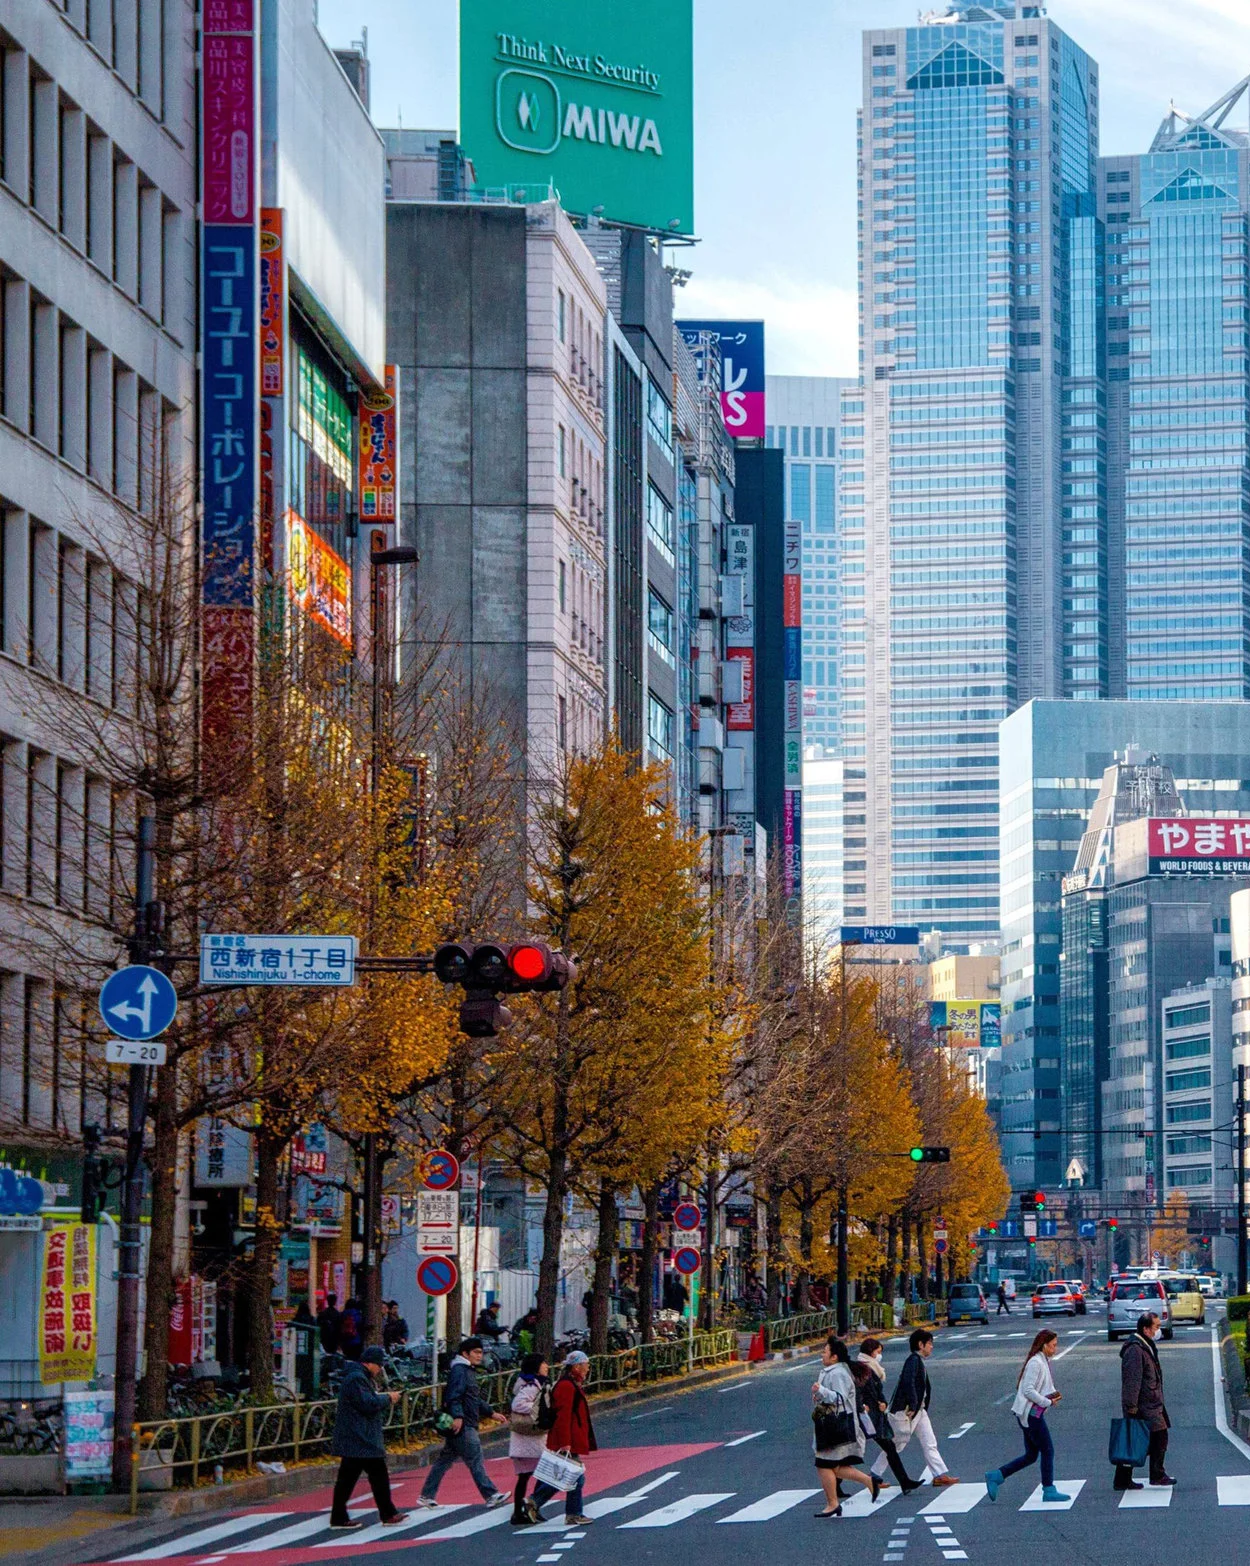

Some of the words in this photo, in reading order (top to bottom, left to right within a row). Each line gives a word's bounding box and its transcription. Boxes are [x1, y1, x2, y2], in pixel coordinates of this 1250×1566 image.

[498, 33, 548, 62] Think
[552, 45, 590, 71] Next
[594, 55, 660, 89] Security
[209, 40, 228, 219] 品川スキンクリニック
[562, 102, 663, 156] MIWA
[731, 528, 750, 537] 新宿
[786, 525, 799, 570] ニチワ
[788, 682, 798, 730] KASHIWA
[1159, 861, 1187, 871] WORLD
[1188, 861, 1214, 871] FOODS
[1214, 861, 1221, 871] &
[864, 928, 896, 940] PRESSO
[210, 948, 346, 968] 西新宿1丁目
[213, 968, 287, 981] Nishishinjuku
[292, 968, 341, 980] 1-chome
[949, 1009, 977, 1020] 冬の男
